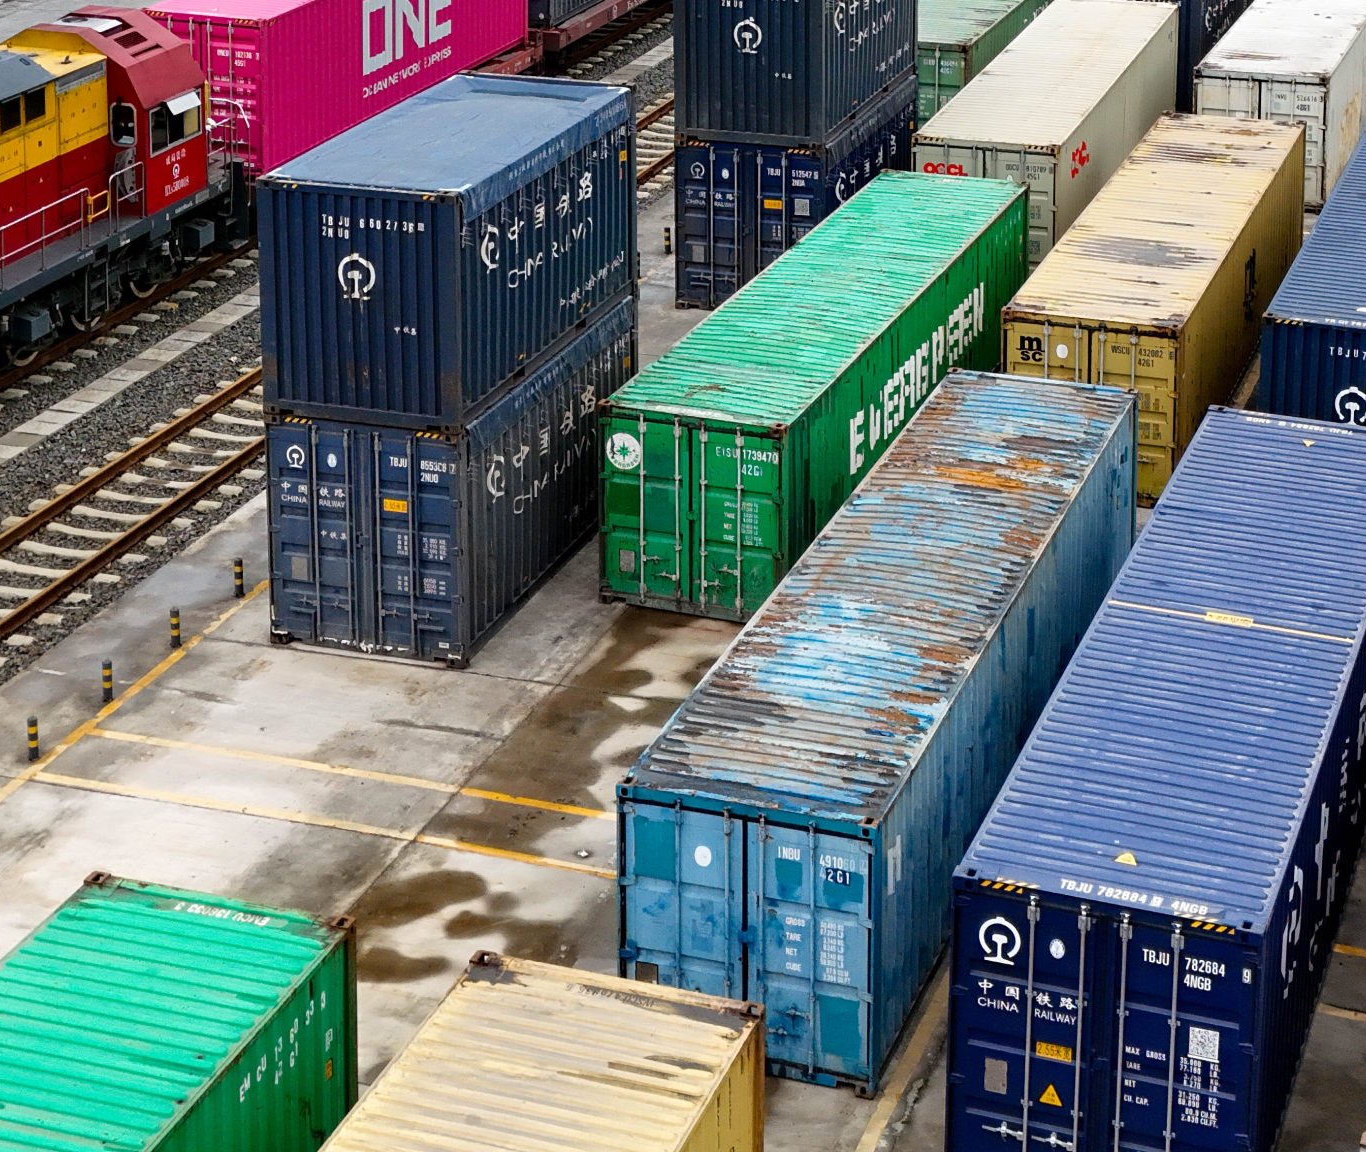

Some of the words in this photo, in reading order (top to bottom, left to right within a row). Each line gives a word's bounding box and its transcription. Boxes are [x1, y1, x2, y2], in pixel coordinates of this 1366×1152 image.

[321, 214, 350, 227] TBJU
[389, 456, 408, 468] TBJU
[281, 481, 346, 498] 中国铁路
[281, 493, 308, 504] CHINA
[319, 498, 346, 508] RAILWAY
[777, 845, 801, 861] INBU
[1059, 878, 1093, 895] TBJU
[1097, 885, 1147, 905] 782684
[1170, 901, 1209, 916] 4NGB
[785, 931, 802, 942] TARE
[785, 946, 798, 957] NET
[785, 961, 802, 972] CUBE
[1142, 948, 1171, 966] TBJU
[1185, 957, 1226, 977] 782684
[1242, 967, 1252, 985] 9
[1183, 975, 1213, 992] 4NGB
[977, 979, 1077, 1010] 中国铁路
[977, 996, 1020, 1013] CHINA
[1034, 1008, 1077, 1026] RAILWAY
[1124, 1045, 1140, 1056] MAX
[1145, 1050, 1167, 1061] GROSS
[1125, 1060, 1142, 1071] TARE
[1124, 1078, 1137, 1088] NET
[1135, 1096, 1150, 1107] CAP.
